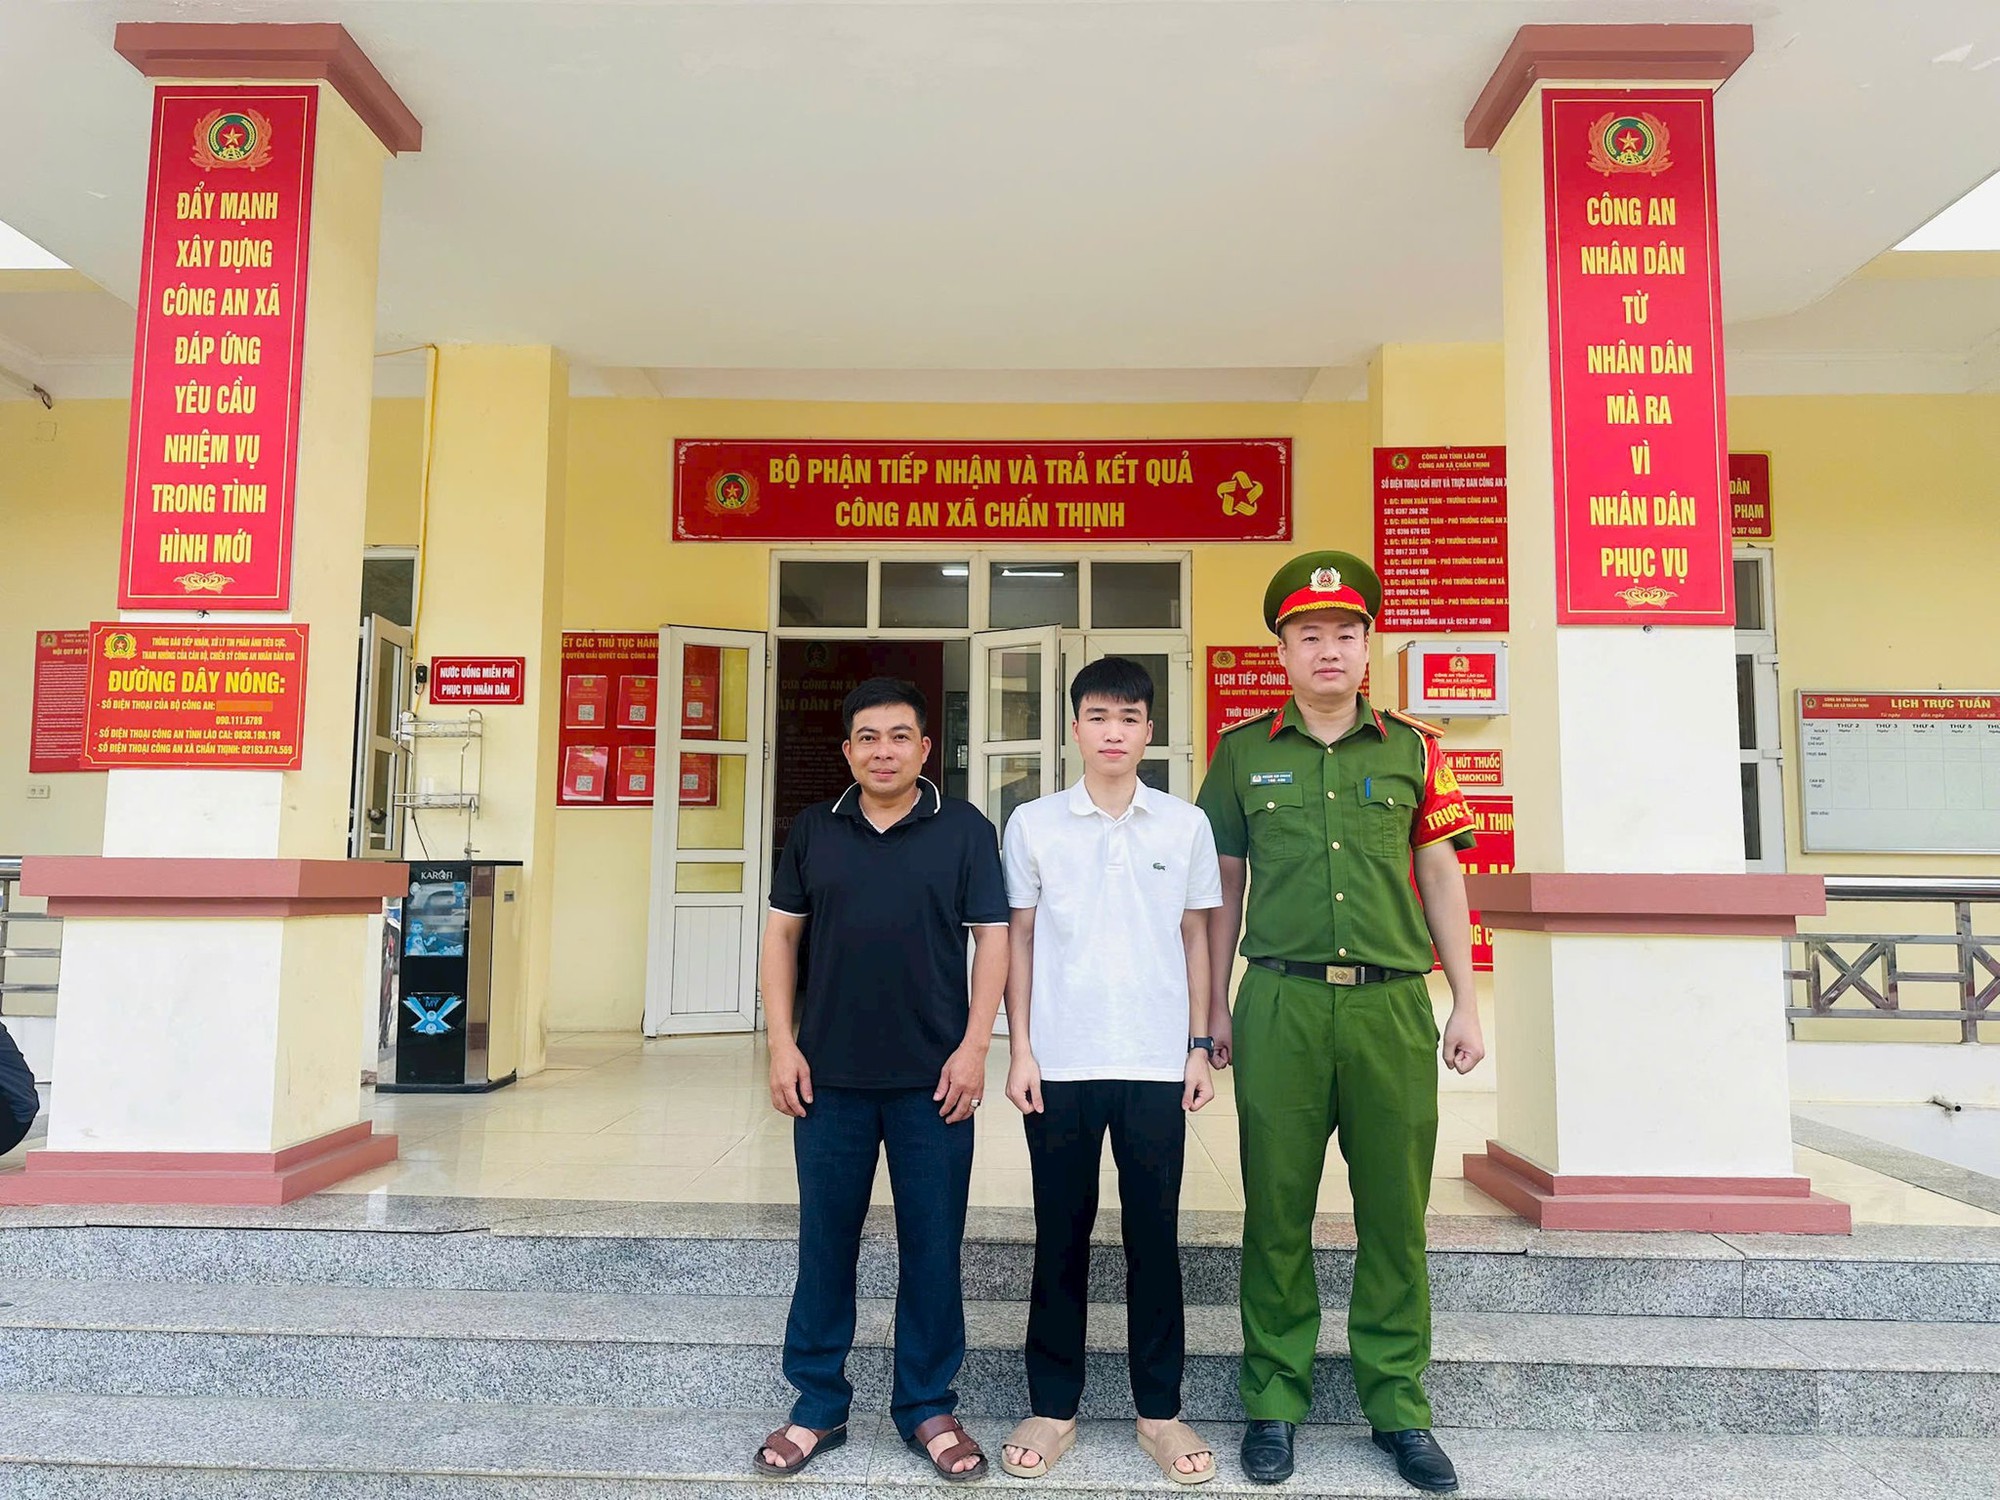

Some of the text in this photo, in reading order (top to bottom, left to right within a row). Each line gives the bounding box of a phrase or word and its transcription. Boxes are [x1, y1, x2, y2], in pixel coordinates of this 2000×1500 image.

[177, 181, 278, 226] ĐẨY MẠNH
[1587, 192, 1676, 226] CÔNG AN
[176, 237, 272, 274] XÂY DỰNG
[1581, 241, 1685, 275] NHÂN DÂN
[162, 282, 280, 316] CÔNG AN XÃ
[1622, 289, 1649, 324] TỪ
[175, 331, 261, 365] ĐÁP ỨNG
[1588, 339, 1693, 374] NHÂN DÂN
[175, 376, 256, 414] YÊU CẦU
[1607, 389, 1672, 425] MÀ RA
[164, 430, 260, 469] NHIỆM VỤ
[1631, 440, 1650, 475] VÌ
[770, 449, 1193, 489] BỘ PHẬN TIẾP NHẬN VÀ TRẢ KẾT QUẢ
[1730, 477, 1750, 494] DÂN
[152, 478, 266, 513] TRONG TÌNH
[1590, 490, 1696, 526] NHÂN DÂN
[836, 494, 1126, 532] CÔNG AN XÃ CHẤN THỊNH
[1734, 504, 1764, 522] PHẠM
[160, 528, 252, 563] HÌNH MỚI
[1601, 548, 1688, 584] PHỤC VỤ
[576, 635, 594, 648] CÁC
[598, 634, 615, 648] THỦ
[618, 638, 635, 650] TỤC
[108, 664, 286, 694] ĐƯỜNG DÂY NÓNG:
[440, 664, 515, 678] NƯỚC UỐNG MIỄN PHÍ
[1215, 670, 1285, 688] LỊCH TIẾP CÔNG
[101, 697, 112, 709] SỐ
[113, 698, 130, 711] ĐIỆN
[132, 700, 152, 711] THOẠI
[154, 698, 168, 710] CỦA
[170, 699, 180, 712] BỘ
[182, 699, 201, 710] CÔNG
[442, 682, 510, 698] PHỤC VỤ NHÂN DÂN
[1891, 698, 1919, 710] LỊCH
[1922, 698, 1954, 710] TRỰC
[98, 740, 108, 752] SỐ
[110, 742, 127, 754] ĐIỆN
[129, 744, 149, 755] THOẠI
[151, 742, 170, 753] CÔNG
[172, 744, 182, 753] AN
[184, 743, 194, 753] XÃ
[99, 726, 110, 738] SỐ
[111, 727, 128, 740] ĐIỆN
[130, 729, 150, 740] THOẠI
[152, 728, 171, 738] CÔNG
[173, 729, 184, 738] AN
[203, 728, 217, 739] LÀO
[1456, 753, 1471, 768] HÚT
[1474, 752, 1500, 768] THUỐC
[1456, 774, 1498, 782] SMOKING
[1425, 803, 1464, 830] TRỰC
